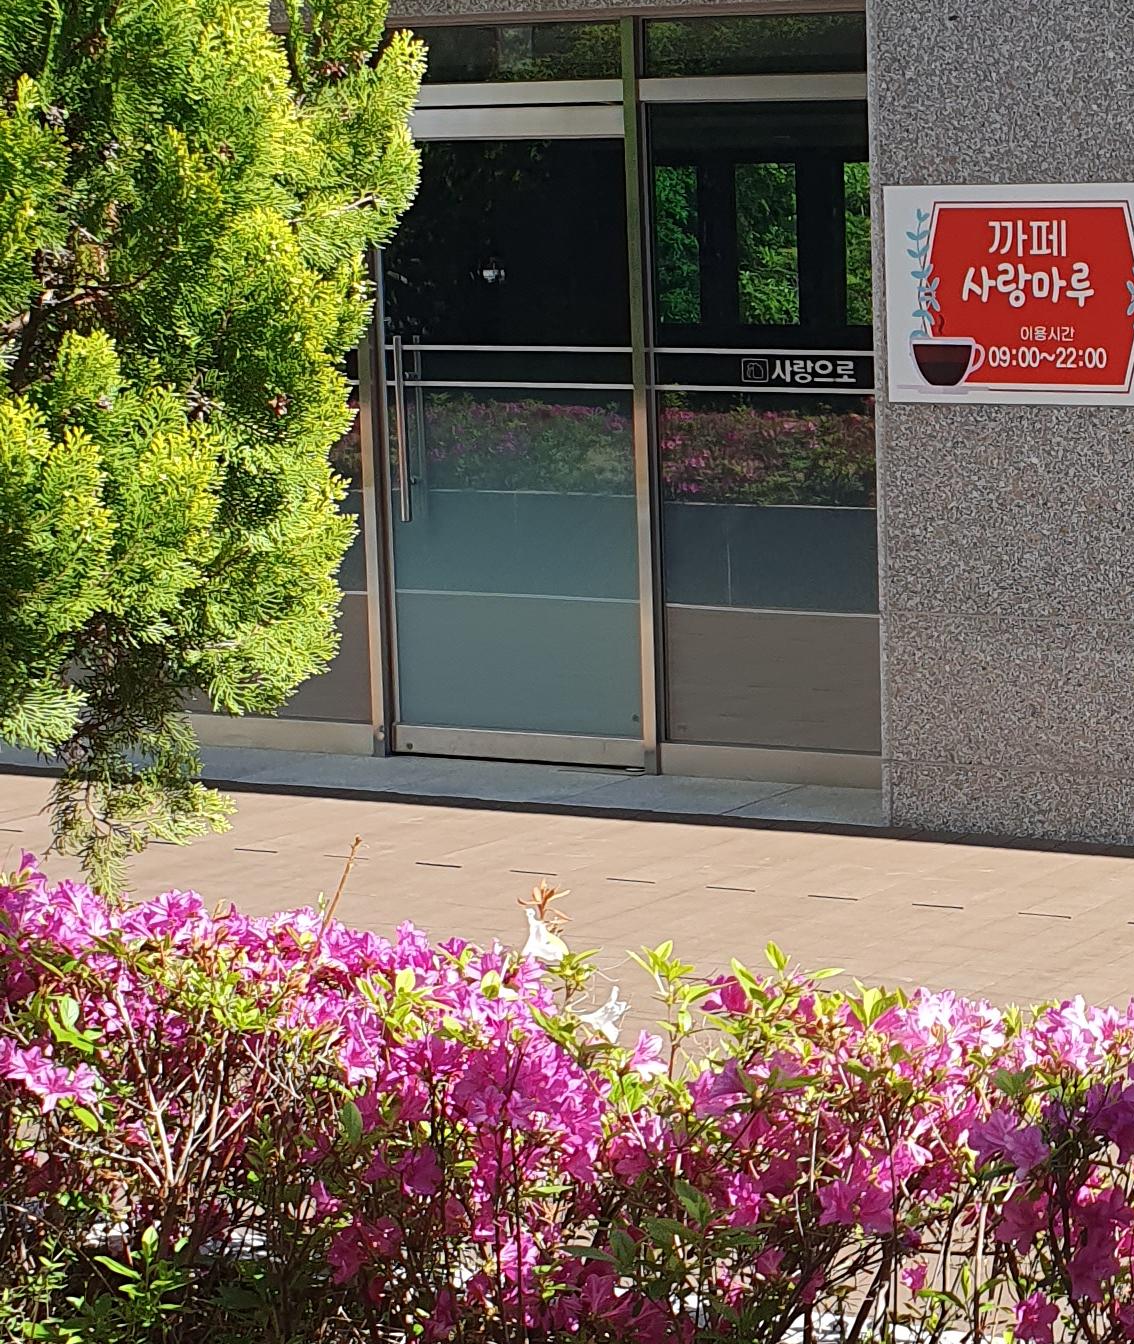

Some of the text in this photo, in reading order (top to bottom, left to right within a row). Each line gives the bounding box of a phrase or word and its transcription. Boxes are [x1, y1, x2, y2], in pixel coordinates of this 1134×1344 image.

[988, 219, 1067, 257] 까페
[961, 262, 1095, 308] 사랑마루
[1020, 327, 1075, 342] 이용시간
[988, 347, 1107, 369] 09:00~22:00
[771, 359, 857, 383] 사랑으로
